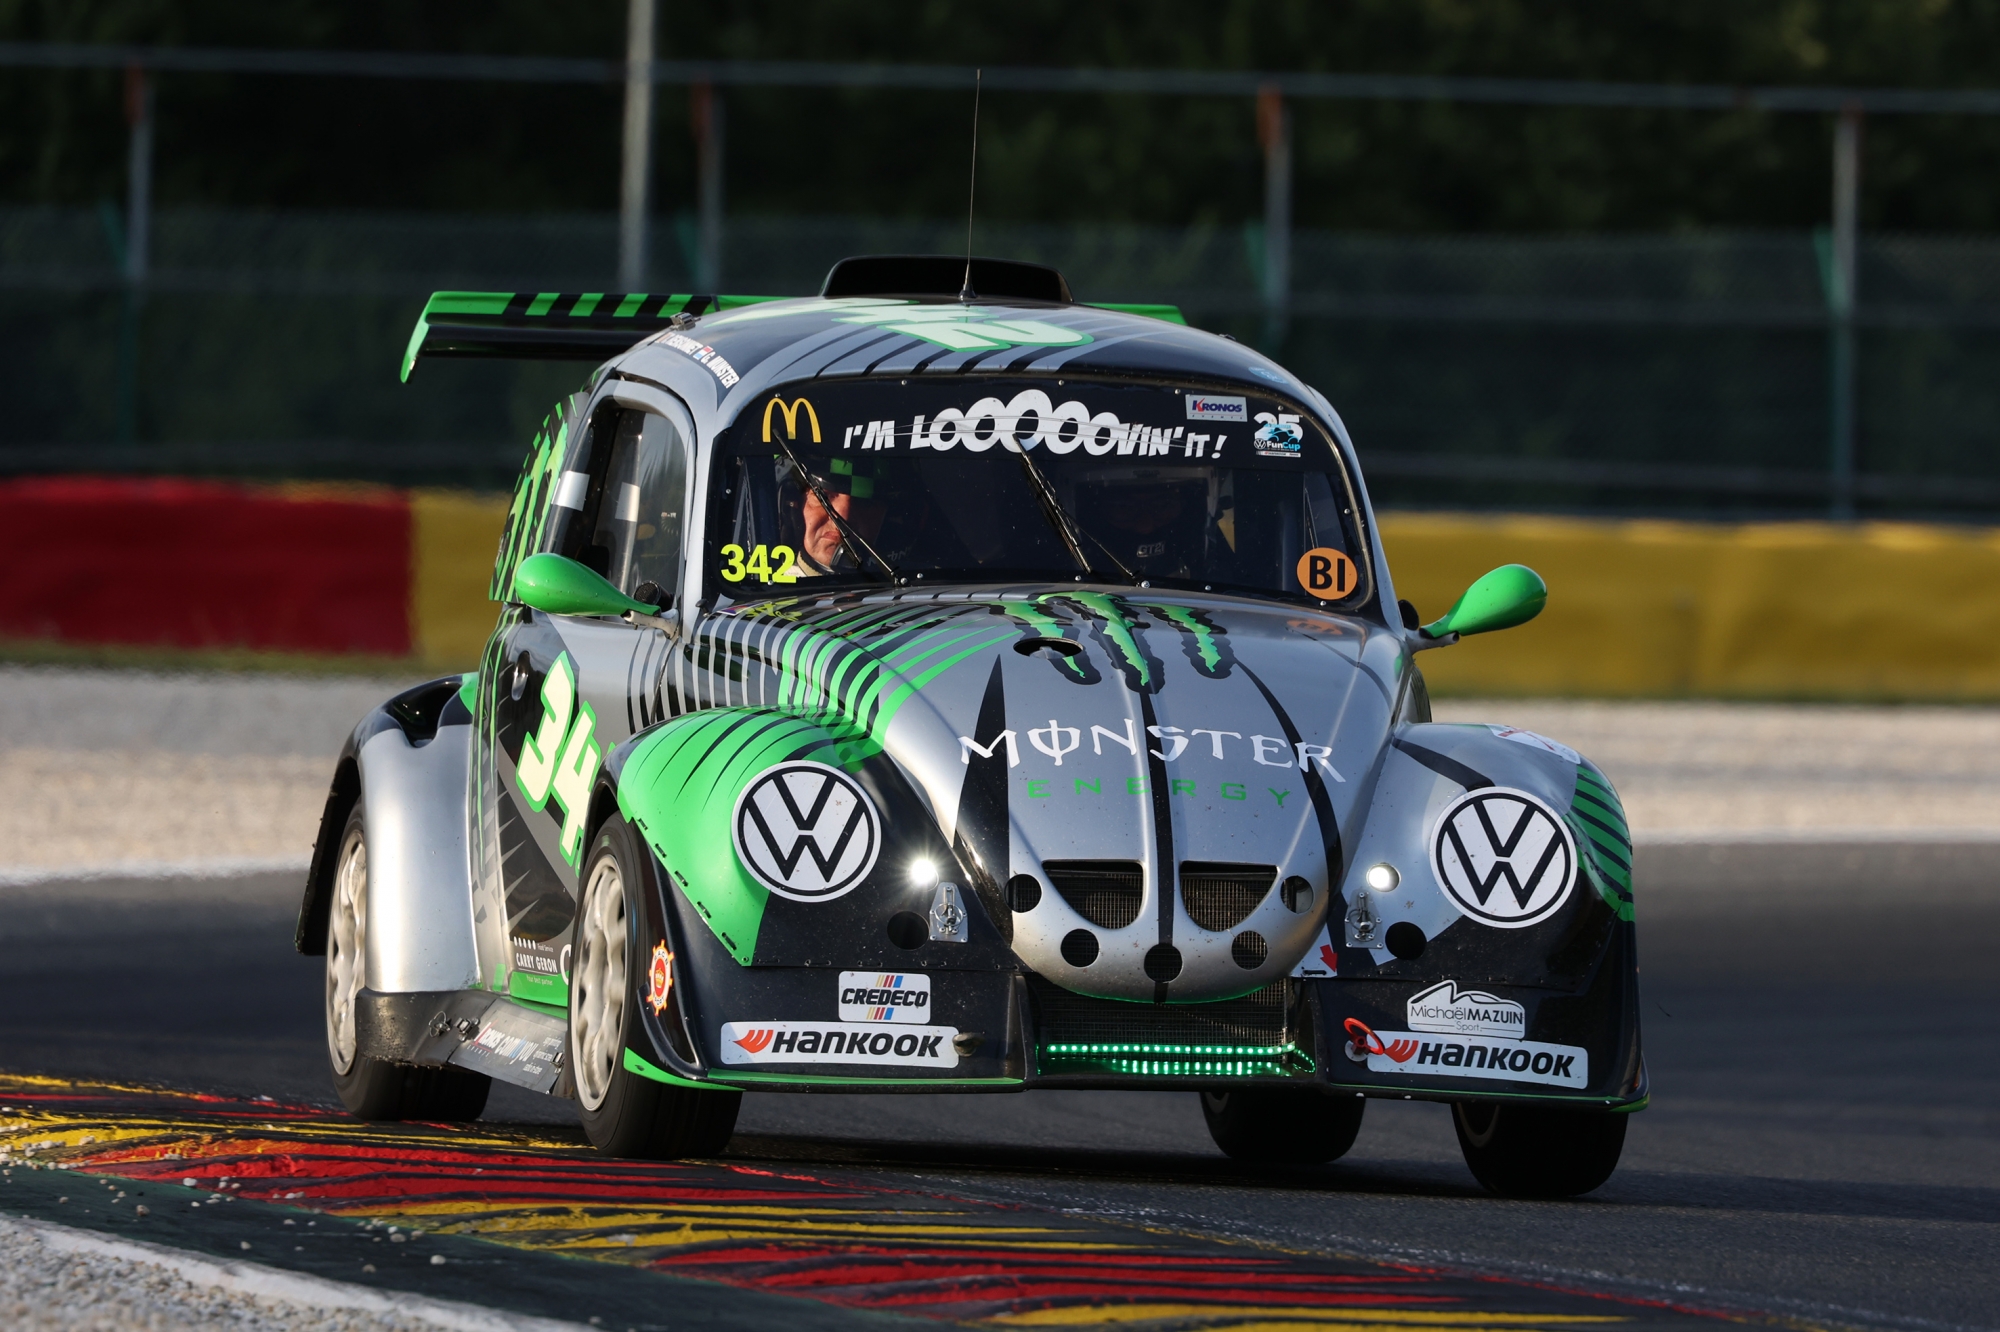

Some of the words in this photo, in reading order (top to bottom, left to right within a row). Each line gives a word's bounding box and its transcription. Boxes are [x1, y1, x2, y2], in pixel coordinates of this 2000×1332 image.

[1192, 398, 1243, 413] KRONOS
[843, 420, 895, 451] I'M
[1253, 412, 1304, 441] 25
[1266, 441, 1301, 451] FunCup
[720, 543, 797, 584] 342
[958, 718, 1346, 783] MONSTER
[1027, 775, 1292, 806] ENERGY
[516, 952, 535, 968] CARRY
[535, 956, 558, 973] GERON
[841, 988, 928, 1007] CREDECO
